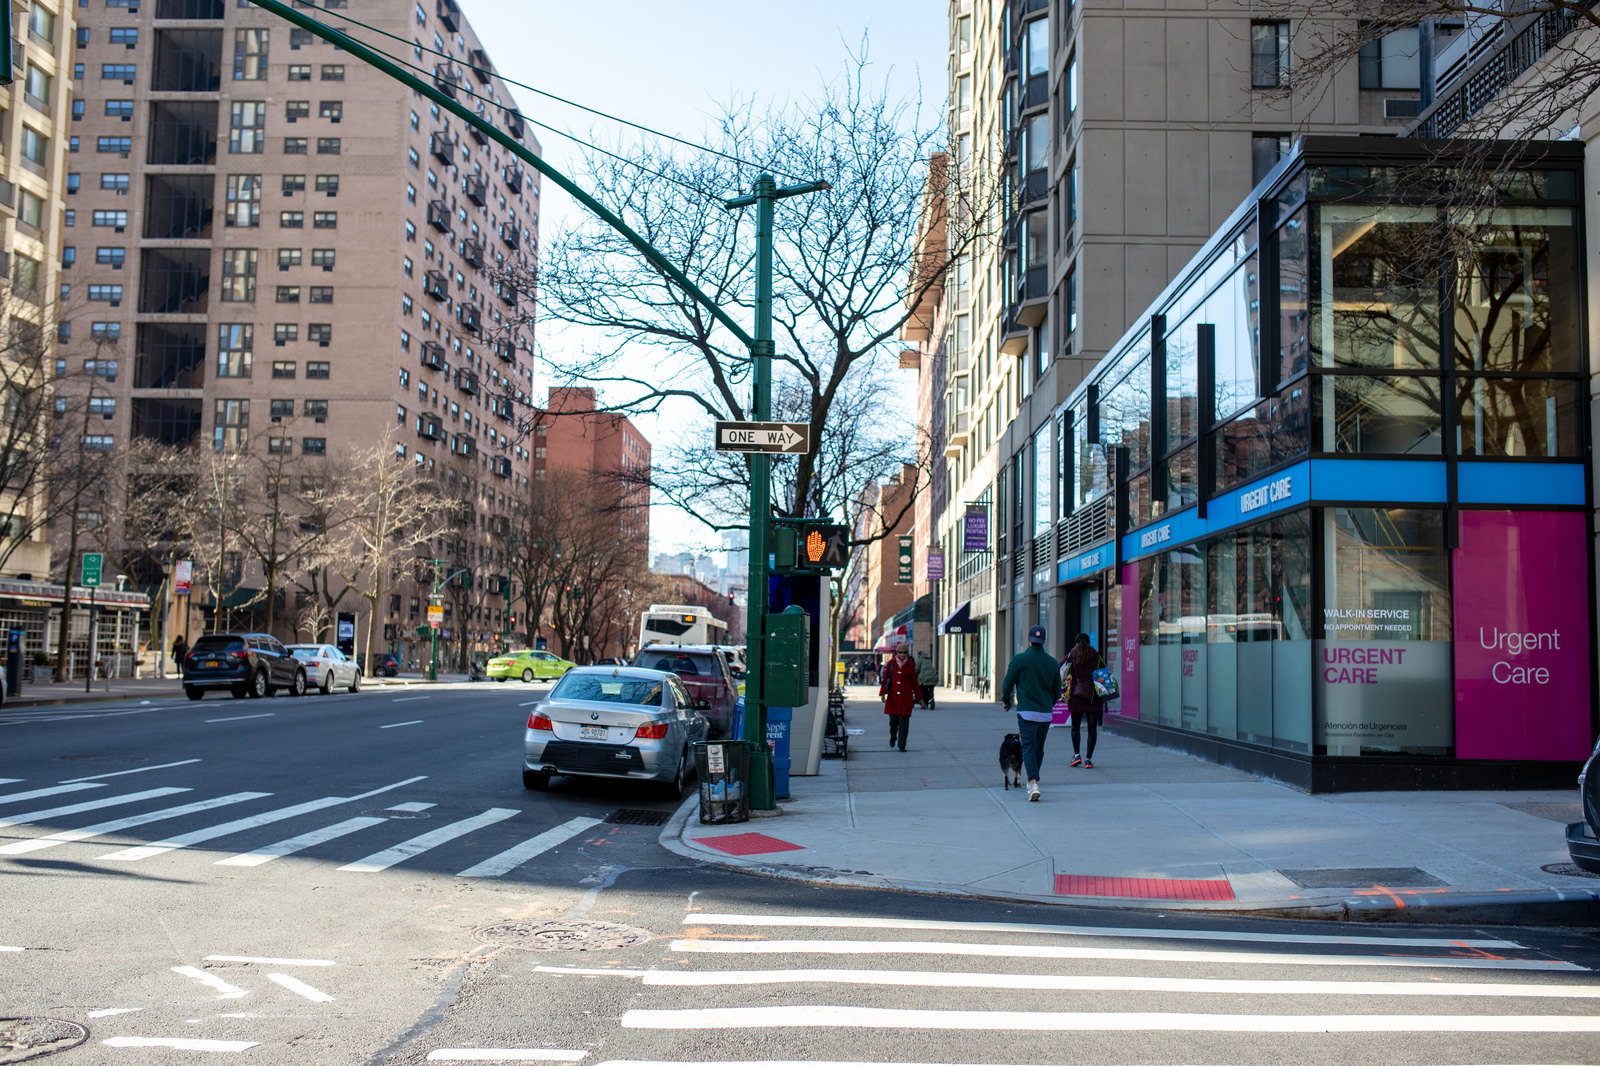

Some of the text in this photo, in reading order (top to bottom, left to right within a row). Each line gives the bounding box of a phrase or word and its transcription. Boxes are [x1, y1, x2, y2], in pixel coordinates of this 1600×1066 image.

[729, 431, 795, 444] ONE WAY
[1241, 476, 1292, 513] URGENT CARE
[1324, 609, 1410, 619] WALK-IN SERVICE
[1384, 624, 1412, 632] NEEDED
[1480, 626, 1561, 655] Urgent
[1324, 648, 1407, 665] URGENT
[1324, 667, 1378, 684] CARE
[1492, 661, 1550, 685] Care
[1324, 721, 1408, 731] Atención de Urgencias
